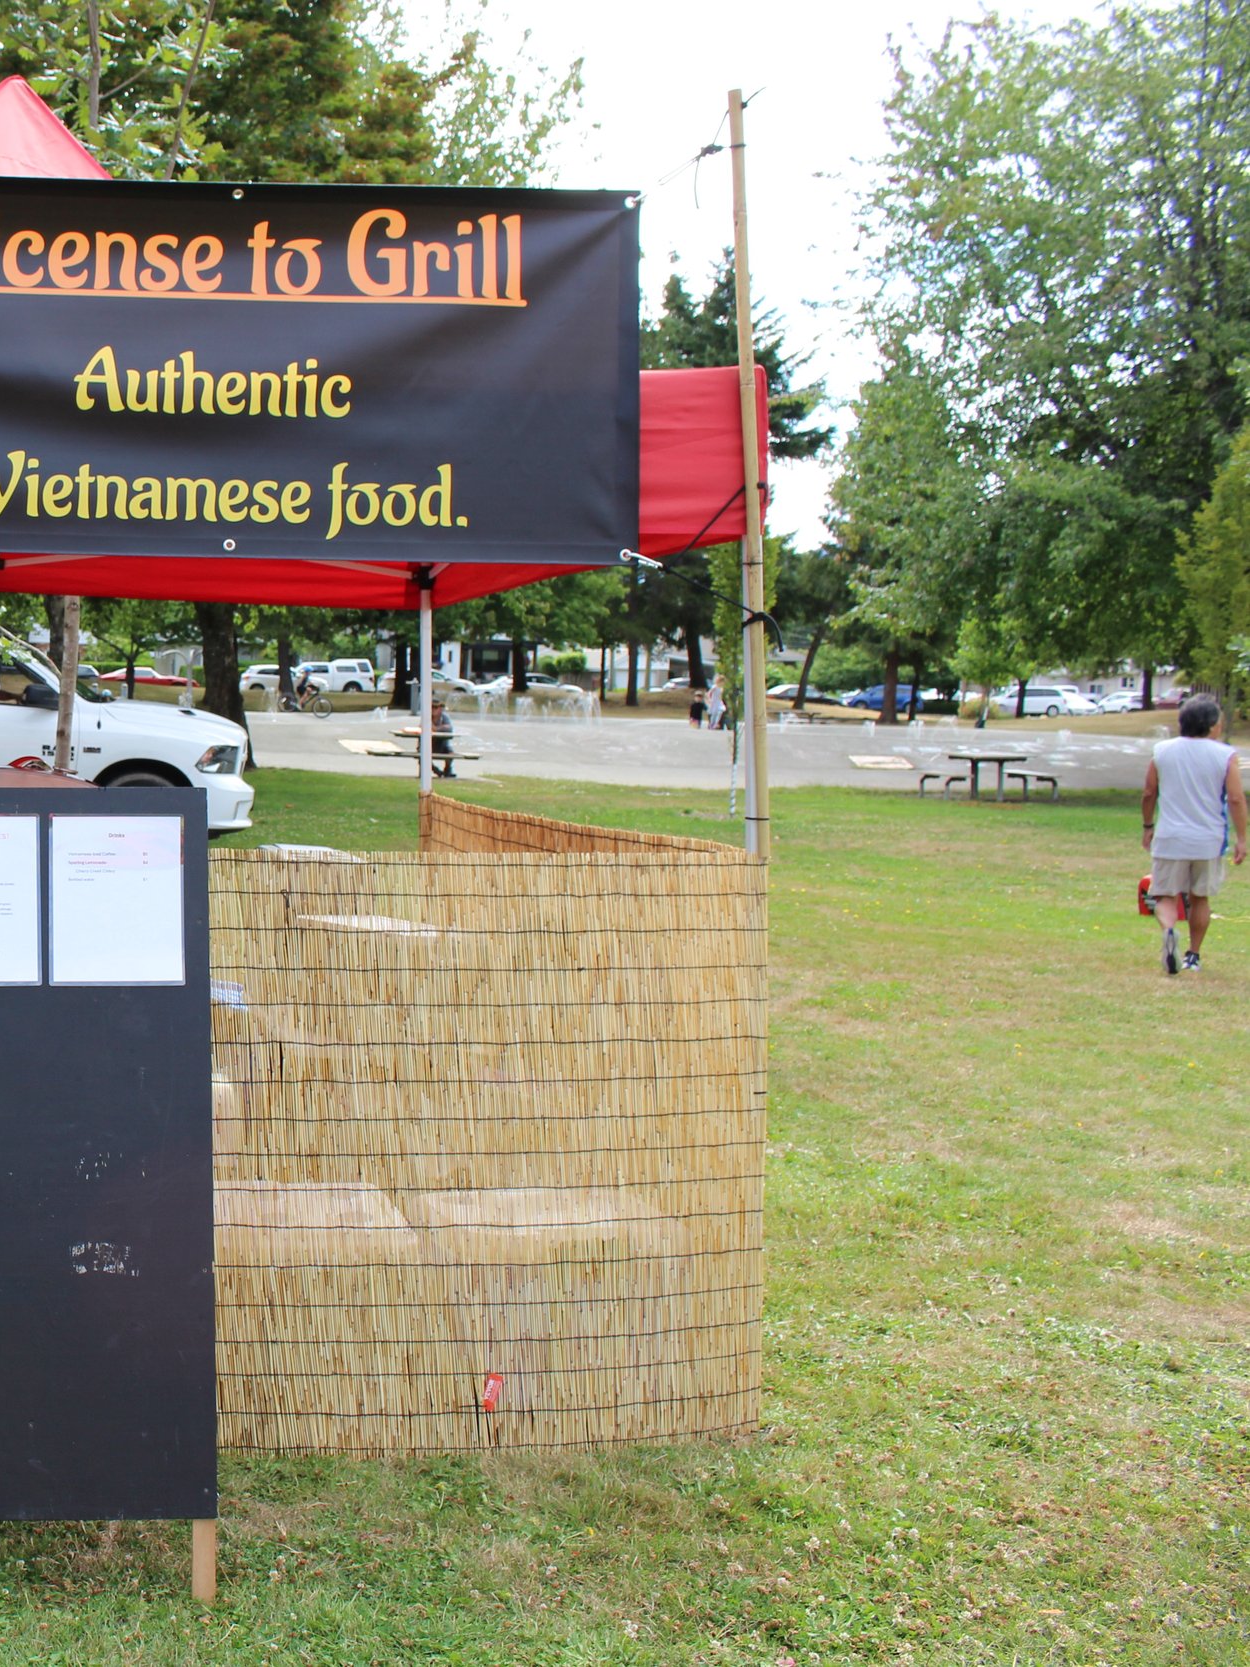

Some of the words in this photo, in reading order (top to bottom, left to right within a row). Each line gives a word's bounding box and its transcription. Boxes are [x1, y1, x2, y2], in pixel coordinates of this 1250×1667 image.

[248, 220, 322, 295] to
[347, 208, 523, 301] Grill
[73, 345, 352, 418] Authentic
[325, 463, 469, 541] food.
